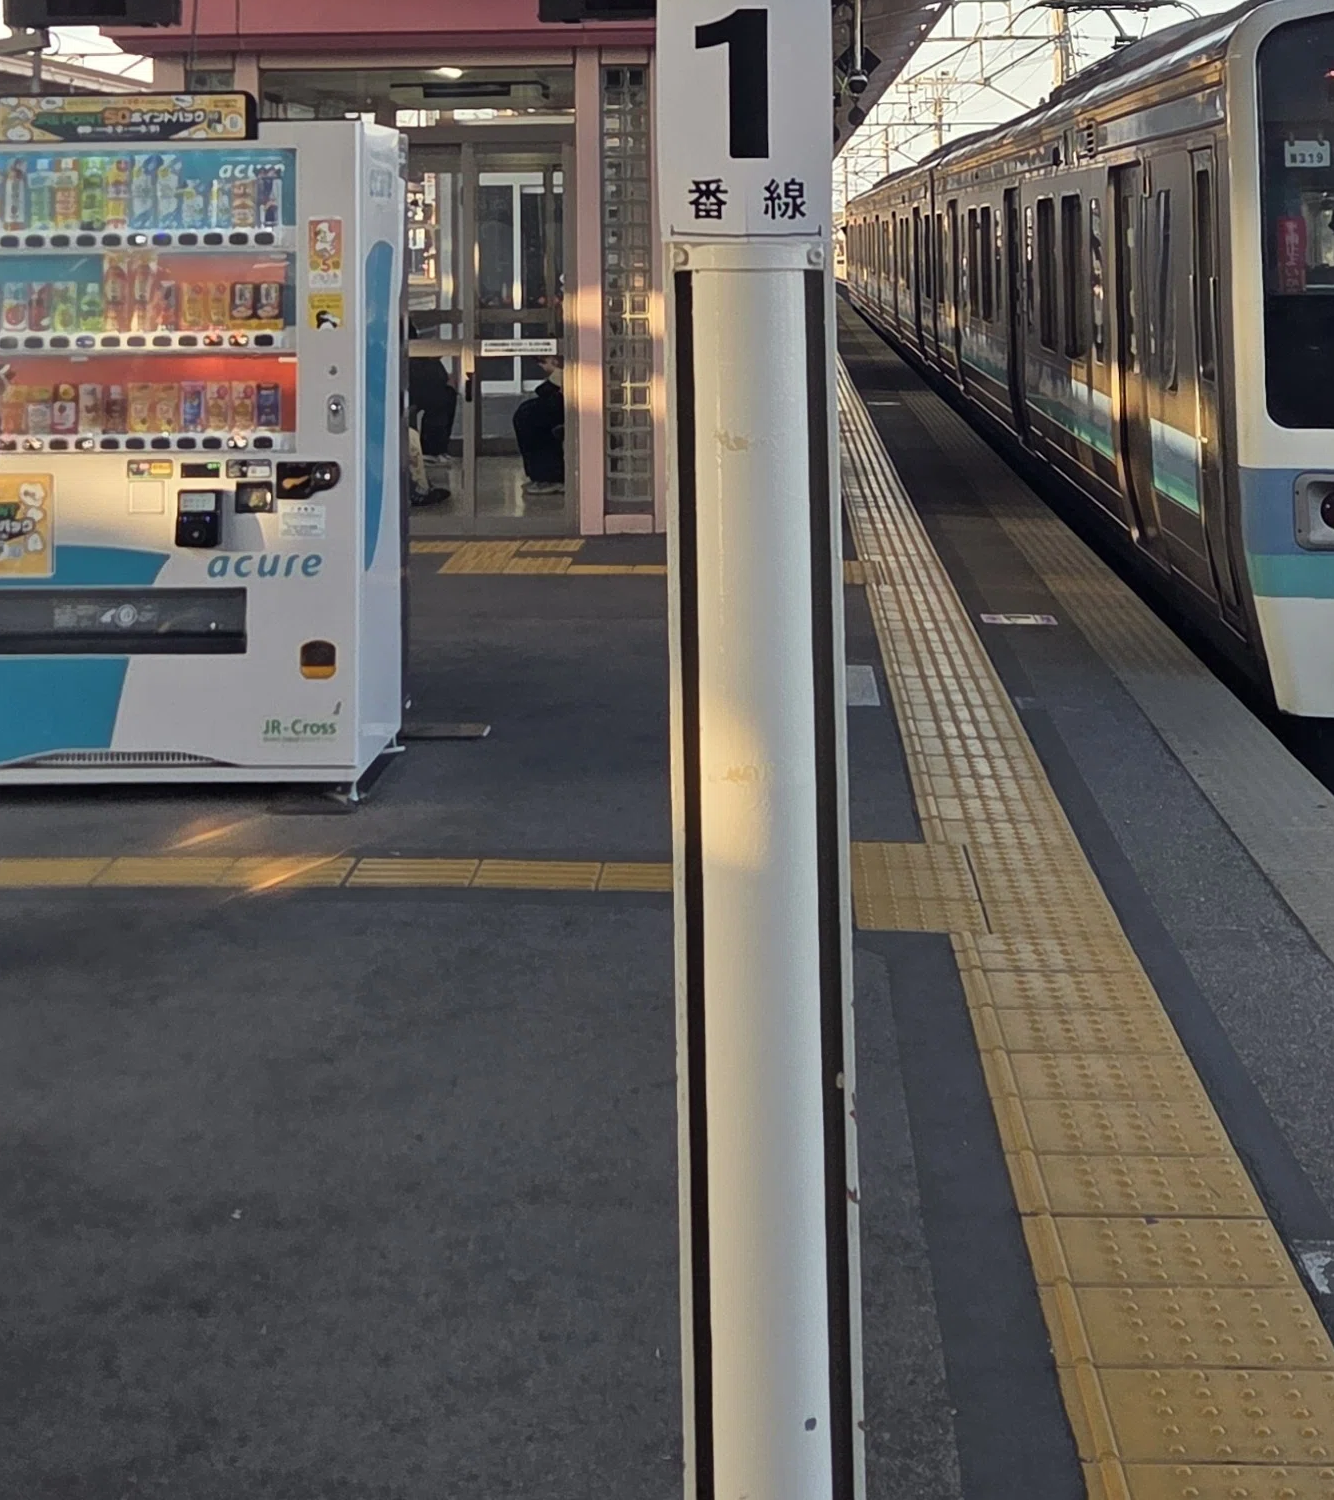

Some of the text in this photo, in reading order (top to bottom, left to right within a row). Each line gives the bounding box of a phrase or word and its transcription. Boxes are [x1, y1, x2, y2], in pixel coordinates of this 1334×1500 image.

[695, 8, 770, 159] 1
[687, 177, 807, 221] 番線
[207, 553, 324, 578] acure
[263, 718, 338, 736] JR-Cross
